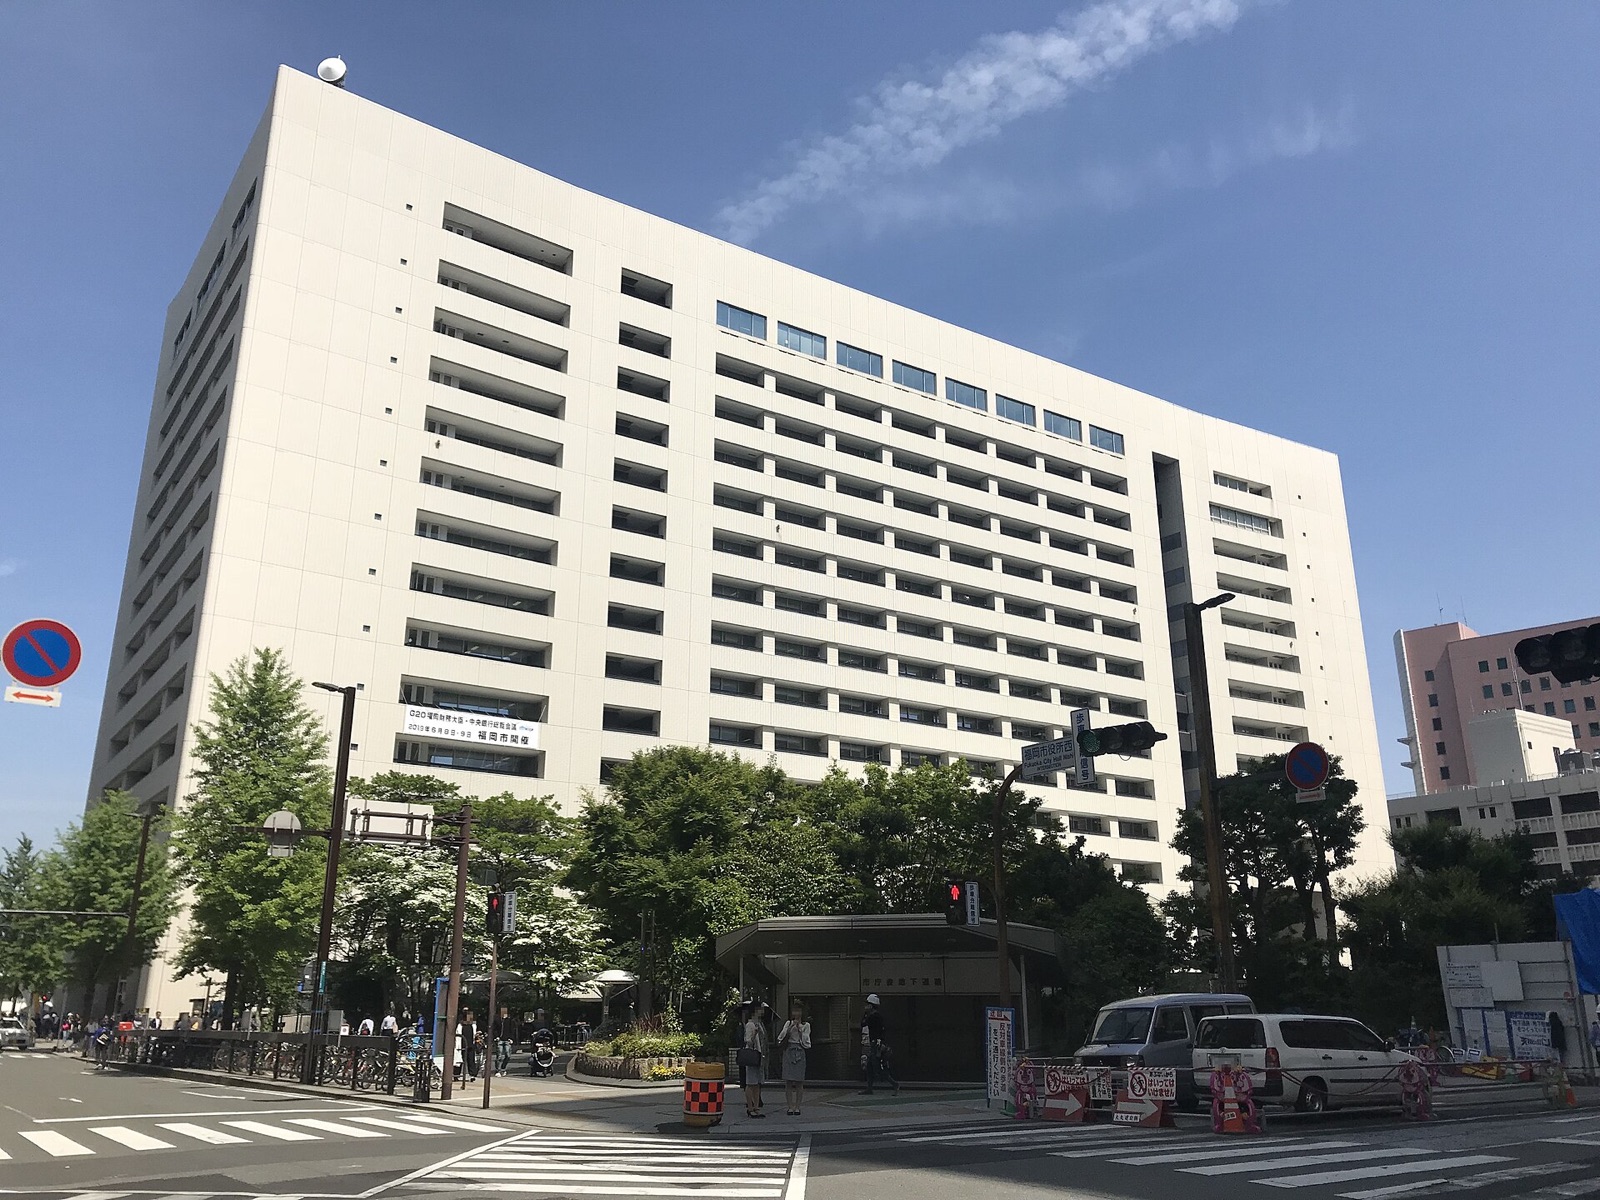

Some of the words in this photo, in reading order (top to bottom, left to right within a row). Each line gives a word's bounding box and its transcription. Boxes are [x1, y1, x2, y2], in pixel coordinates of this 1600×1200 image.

[477, 730, 529, 745] 福岡市開催
[1024, 740, 1073, 761] 福岡市役所西
[1024, 760, 1042, 768] Fukuoka
[1147, 1079, 1175, 1088] はいっては
[1147, 1088, 1175, 1098] いけません
